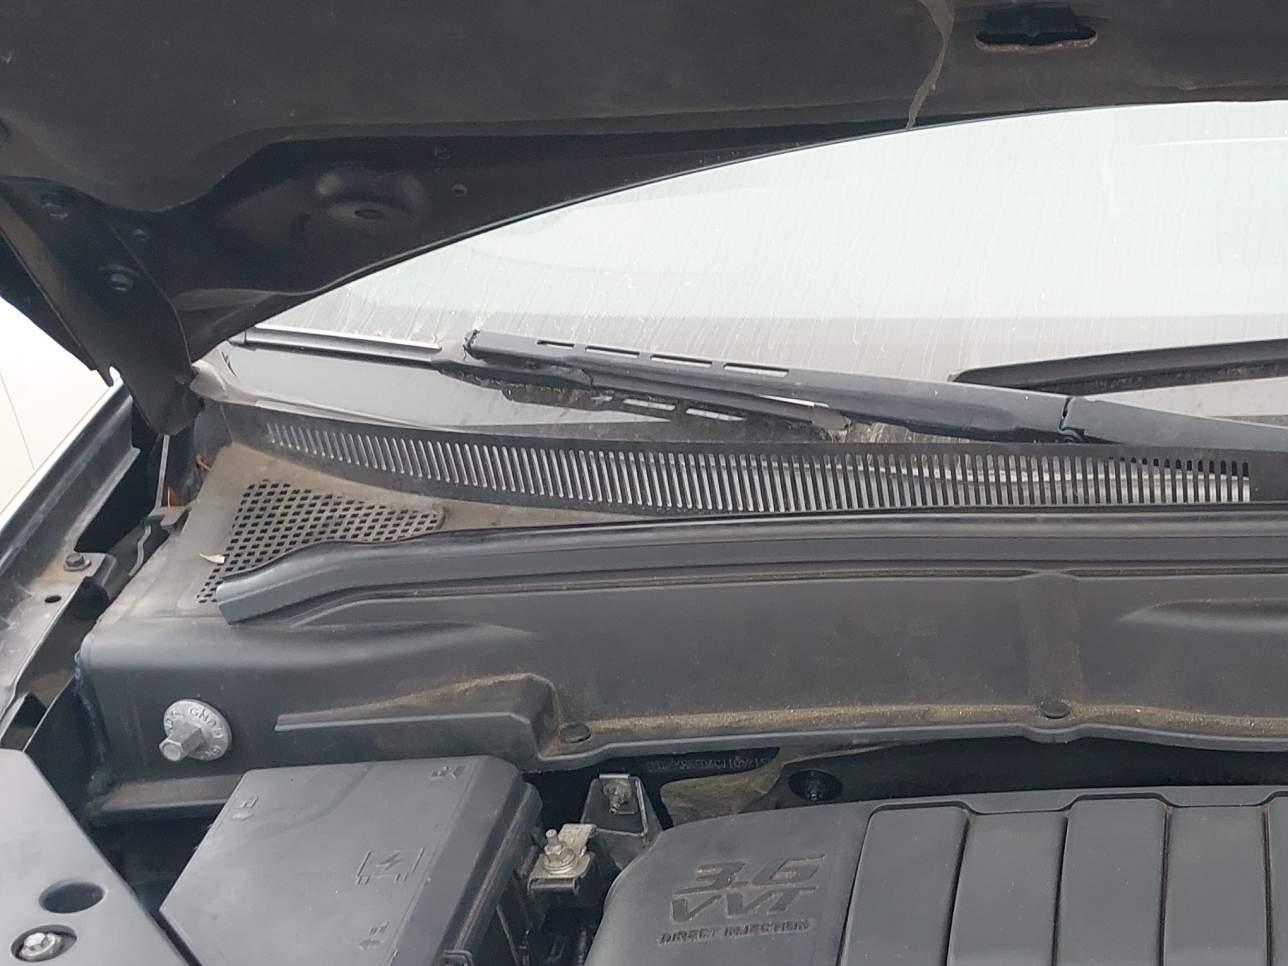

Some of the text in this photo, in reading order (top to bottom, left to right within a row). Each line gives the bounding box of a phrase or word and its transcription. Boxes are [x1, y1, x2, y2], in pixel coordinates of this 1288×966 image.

[672, 854, 825, 896] 3.6
[671, 886, 817, 922] VVT
[659, 919, 810, 945] DIRECT INJECTION
